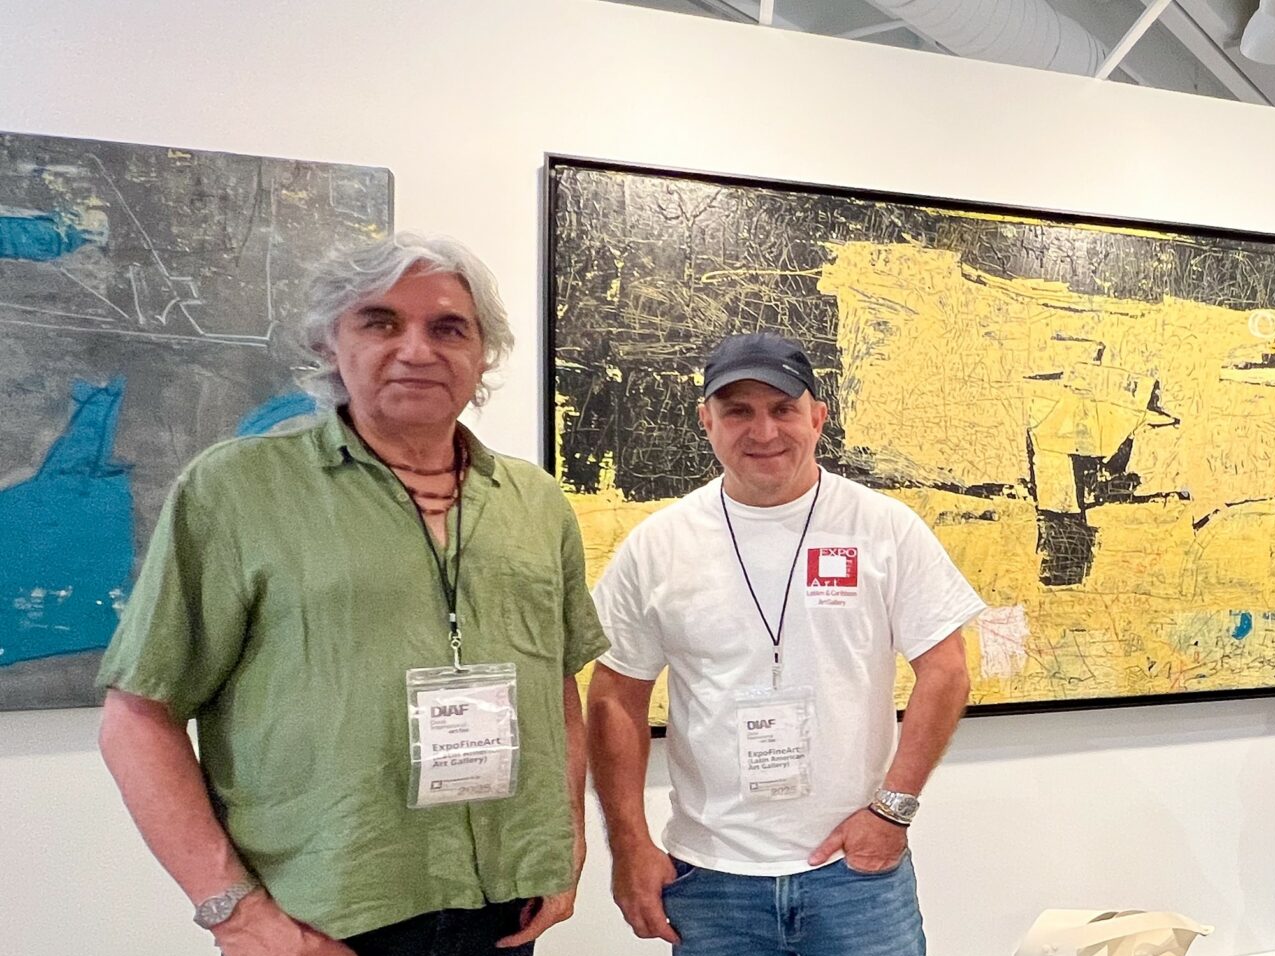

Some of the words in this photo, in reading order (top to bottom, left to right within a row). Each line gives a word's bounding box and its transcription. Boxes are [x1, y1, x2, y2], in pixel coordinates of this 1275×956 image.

[820, 548, 857, 558] EXPO
[810, 578, 837, 588] Art
[430, 704, 469, 718] DIAF
[432, 738, 501, 752] ExpoFineArt
[748, 747, 801, 758] ExpoFineArt
[432, 760, 448, 768] Art
[450, 756, 488, 766] Gallery)
